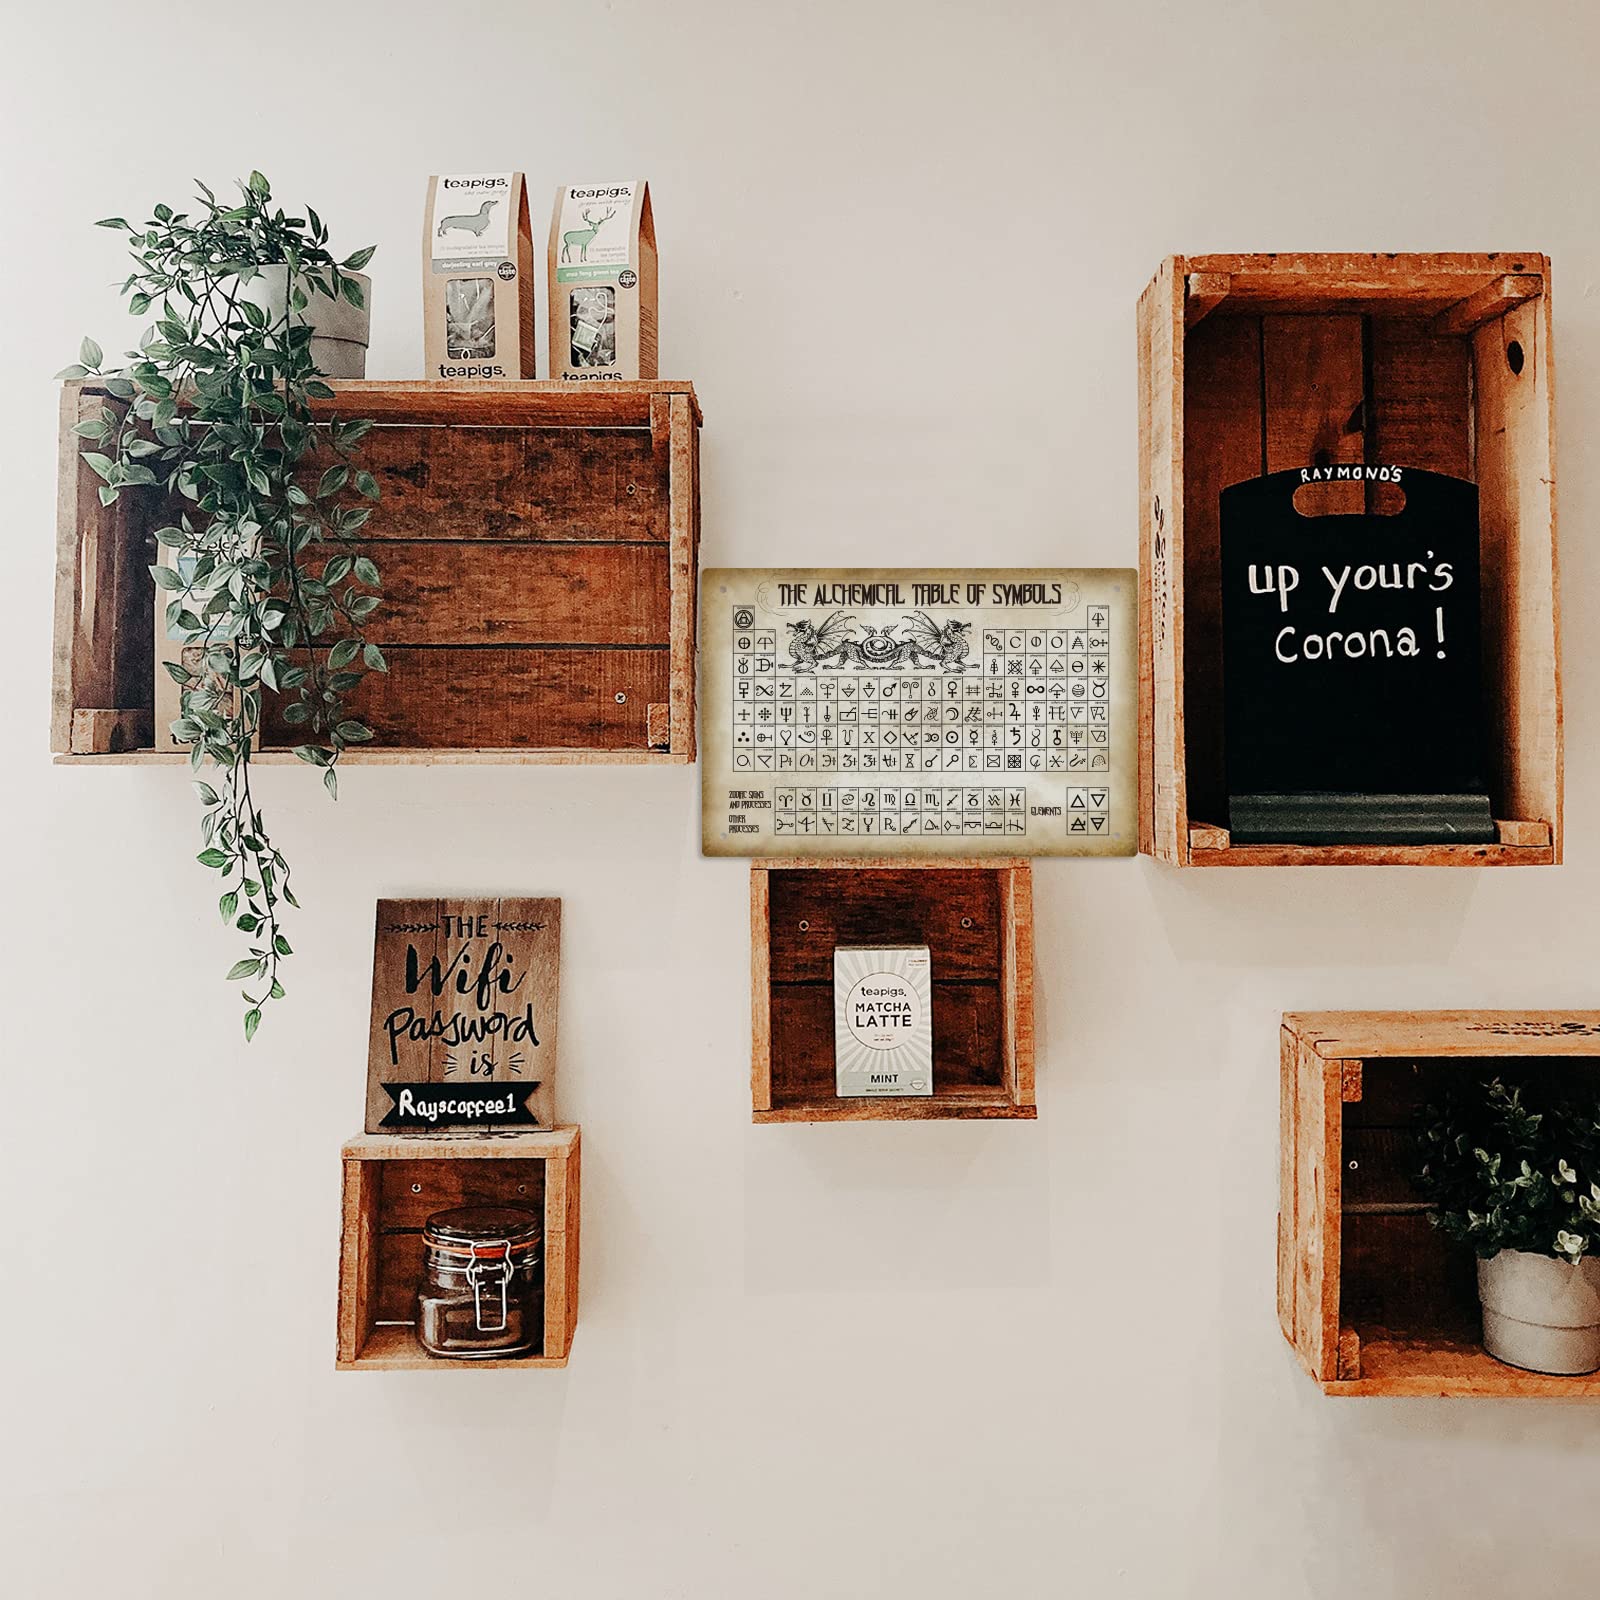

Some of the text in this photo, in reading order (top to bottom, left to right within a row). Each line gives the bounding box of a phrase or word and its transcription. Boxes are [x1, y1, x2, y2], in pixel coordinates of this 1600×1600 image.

[444, 178, 508, 189] teapigs.
[570, 187, 631, 199] teapigs.
[438, 364, 506, 378] teapigs.
[1300, 465, 1403, 483] RAYMOND'S
[1248, 550, 1454, 613] up your's
[778, 583, 1062, 607] THE ALCHEMICAL TABLE OF SYMBOLS
[440, 915, 489, 939] THE
[405, 941, 527, 1011] Wifi
[861, 986, 907, 997] teapigs.
[855, 1002, 912, 1013] MATCHA
[855, 1014, 912, 1028] LATTE
[383, 1003, 540, 1065] Password
[470, 1050, 499, 1076] is
[870, 1074, 899, 1084] MINT
[399, 1088, 517, 1122] Rayscoffee1
